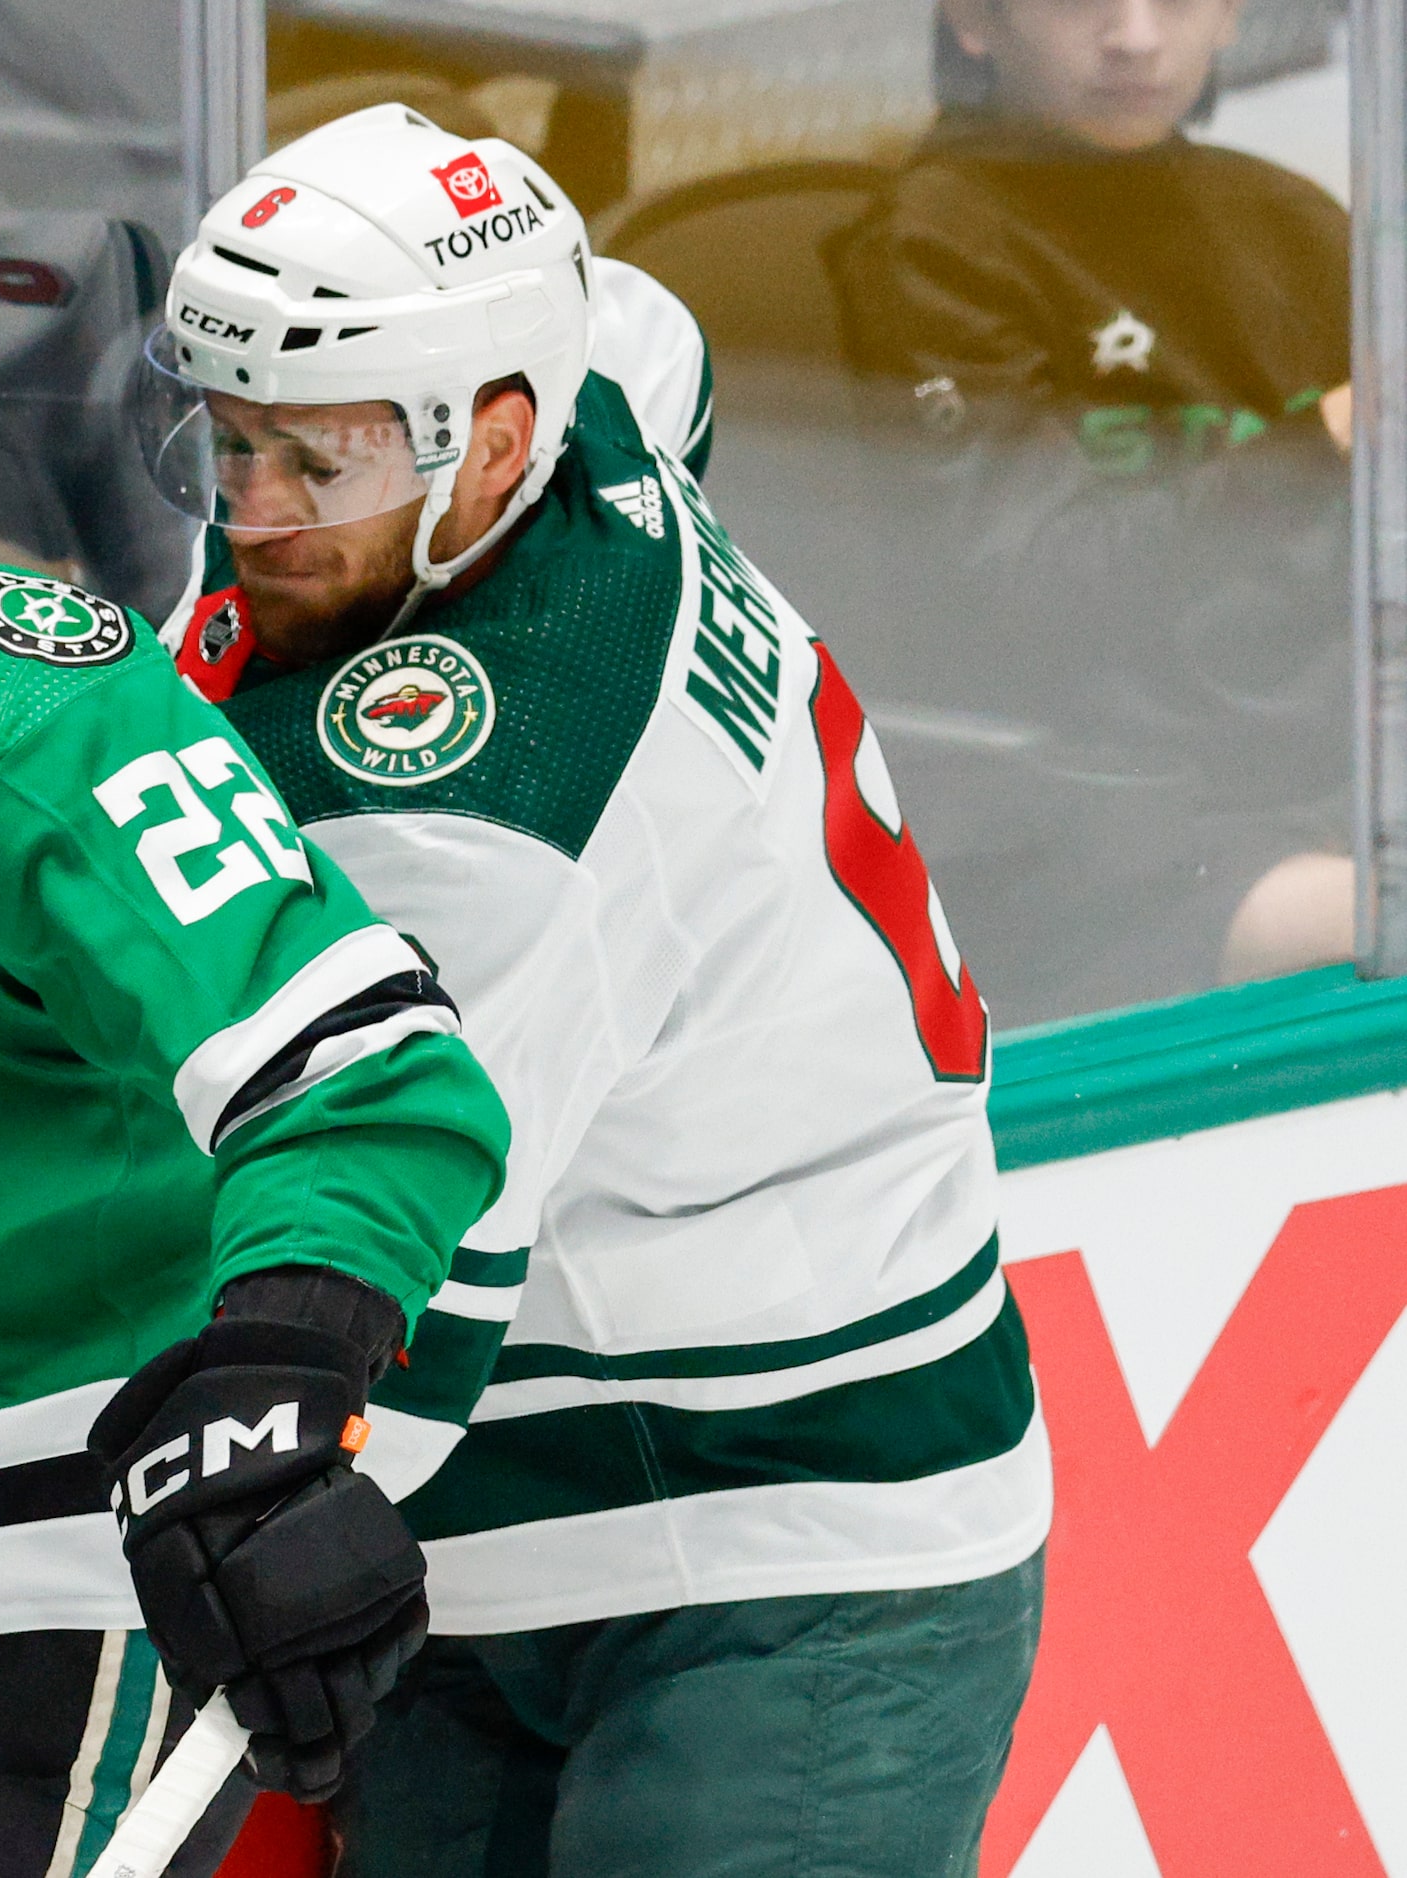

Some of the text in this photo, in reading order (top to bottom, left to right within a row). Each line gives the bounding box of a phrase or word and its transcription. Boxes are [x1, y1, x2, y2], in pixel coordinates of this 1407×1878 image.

[242, 187, 296, 229] 6
[424, 204, 545, 267] TOYOTA
[179, 304, 257, 344] CCM
[642, 474, 665, 539] adidas
[37, 607, 120, 656] STARS
[335, 645, 479, 701] MINNESOTA
[361, 746, 438, 772] WILD
[91, 735, 315, 927] 22
